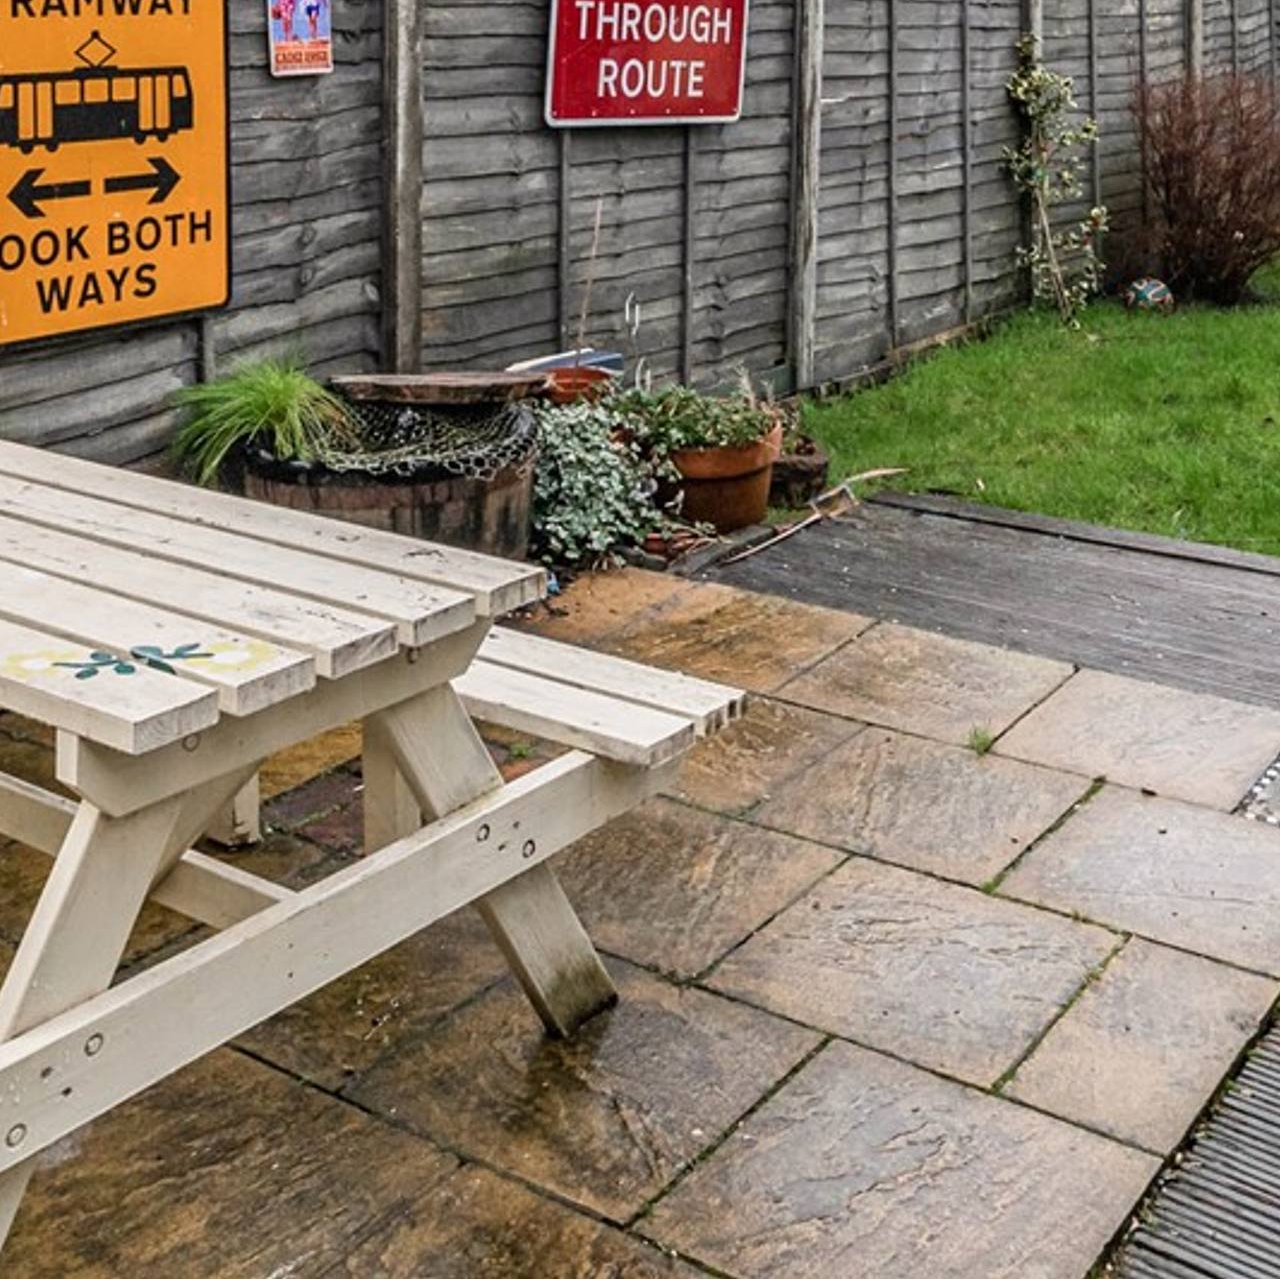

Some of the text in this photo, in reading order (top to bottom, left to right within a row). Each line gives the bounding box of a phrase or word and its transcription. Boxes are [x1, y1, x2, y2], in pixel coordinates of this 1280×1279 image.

[574, 0, 733, 45] THROUGH
[597, 59, 706, 99] ROUTE
[107, 210, 213, 257] BOTH
[36, 263, 158, 315] WAYS
